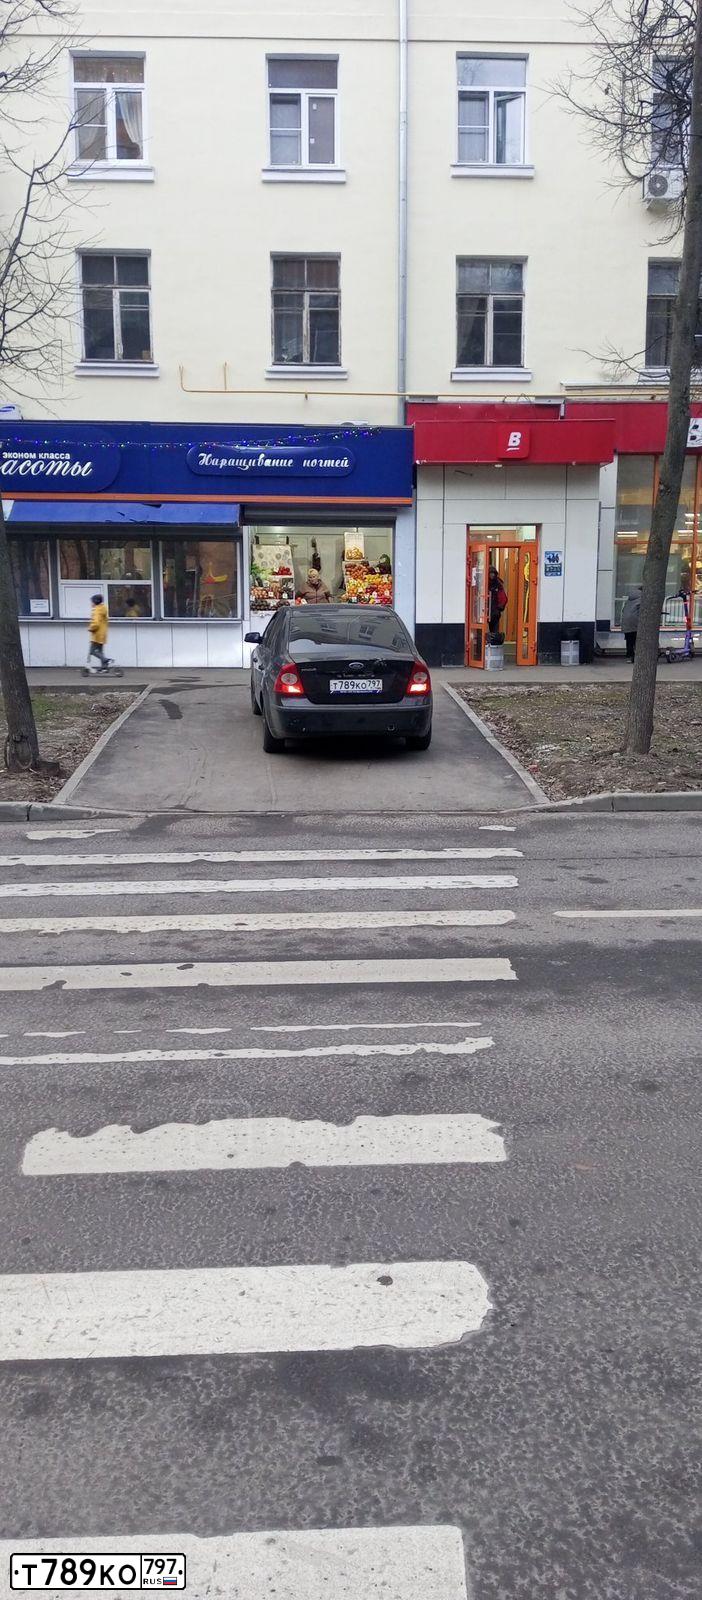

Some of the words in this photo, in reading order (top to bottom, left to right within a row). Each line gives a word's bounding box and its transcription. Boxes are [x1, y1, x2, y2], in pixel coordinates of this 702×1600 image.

[38, 452, 71, 460] класса
[198, 452, 294, 471] Наращивание
[302, 457, 350, 468] ногтей
